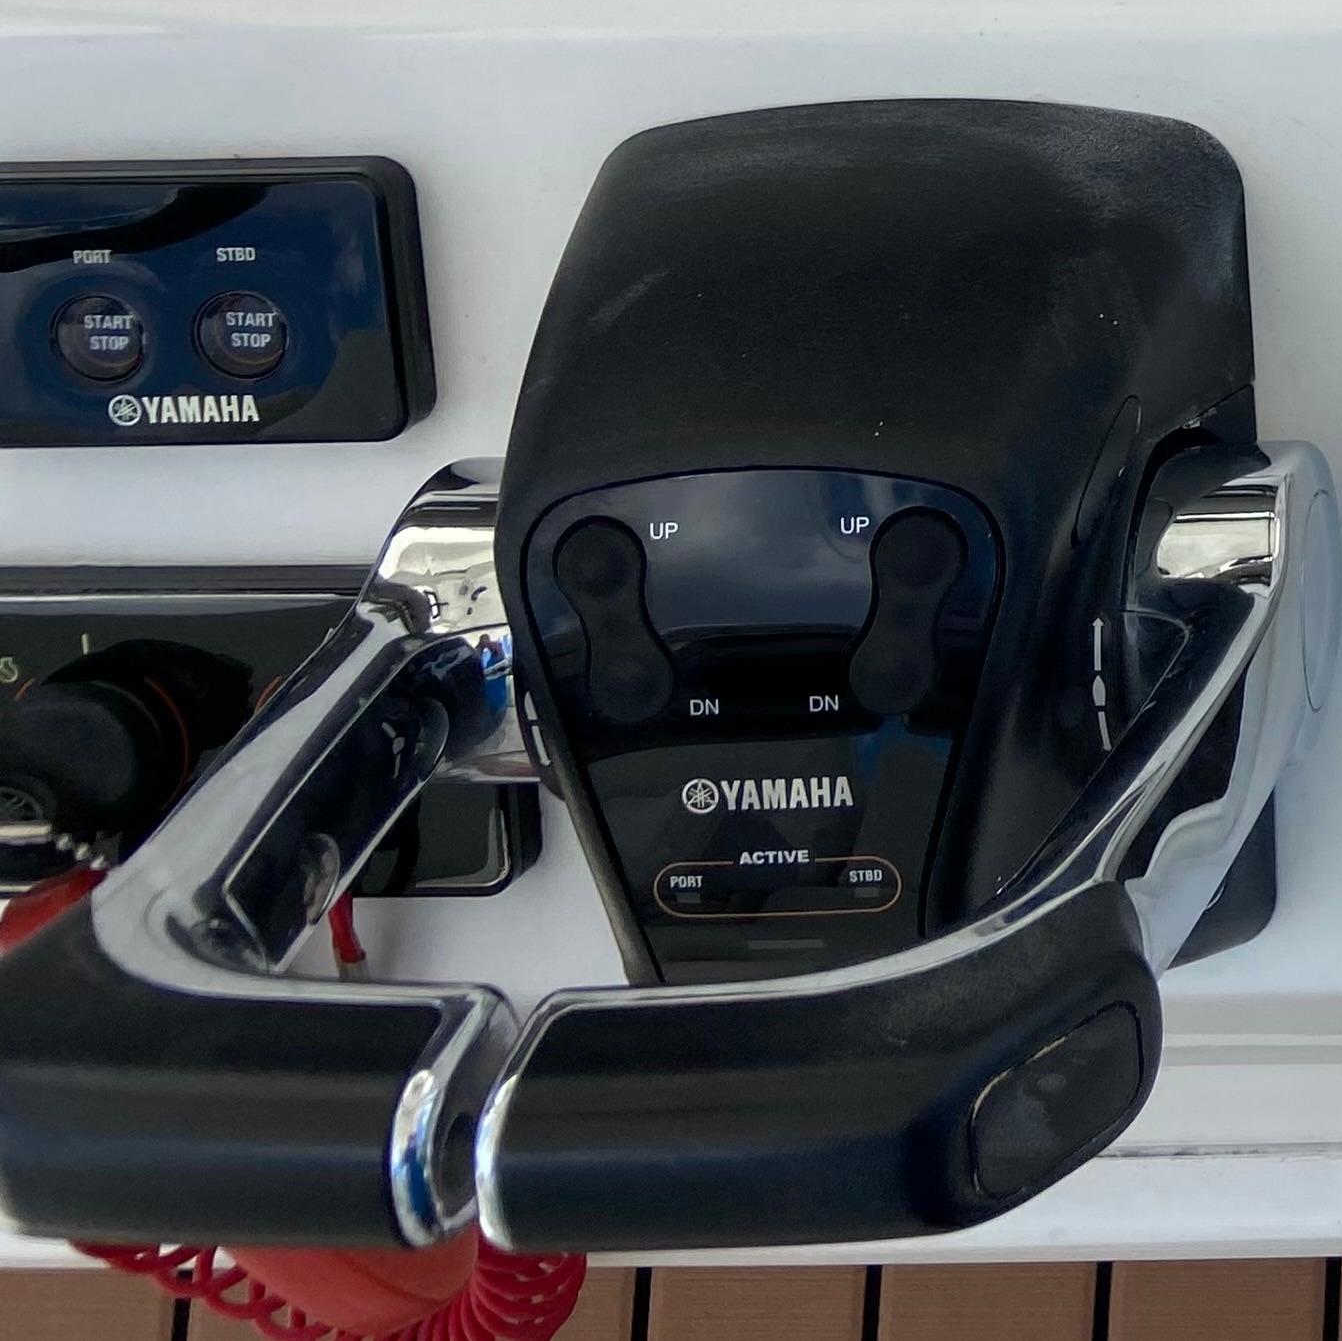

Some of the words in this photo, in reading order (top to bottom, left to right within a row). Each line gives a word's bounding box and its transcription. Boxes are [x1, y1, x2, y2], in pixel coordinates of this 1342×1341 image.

[72, 249, 112, 265] PORT
[216, 246, 256, 262] STBD
[84, 314, 135, 330] START
[225, 311, 276, 327] START
[89, 335, 130, 351] STOP
[231, 333, 272, 349] STOP
[141, 394, 260, 424] YAMAHA
[649, 521, 679, 540] UP
[840, 516, 870, 535] UP
[689, 698, 720, 717] DN
[808, 694, 840, 713] DN
[720, 775, 855, 811] YAMAHA
[738, 848, 811, 867] ACTIVE
[669, 875, 703, 889] PORT
[849, 869, 883, 884] STBD
